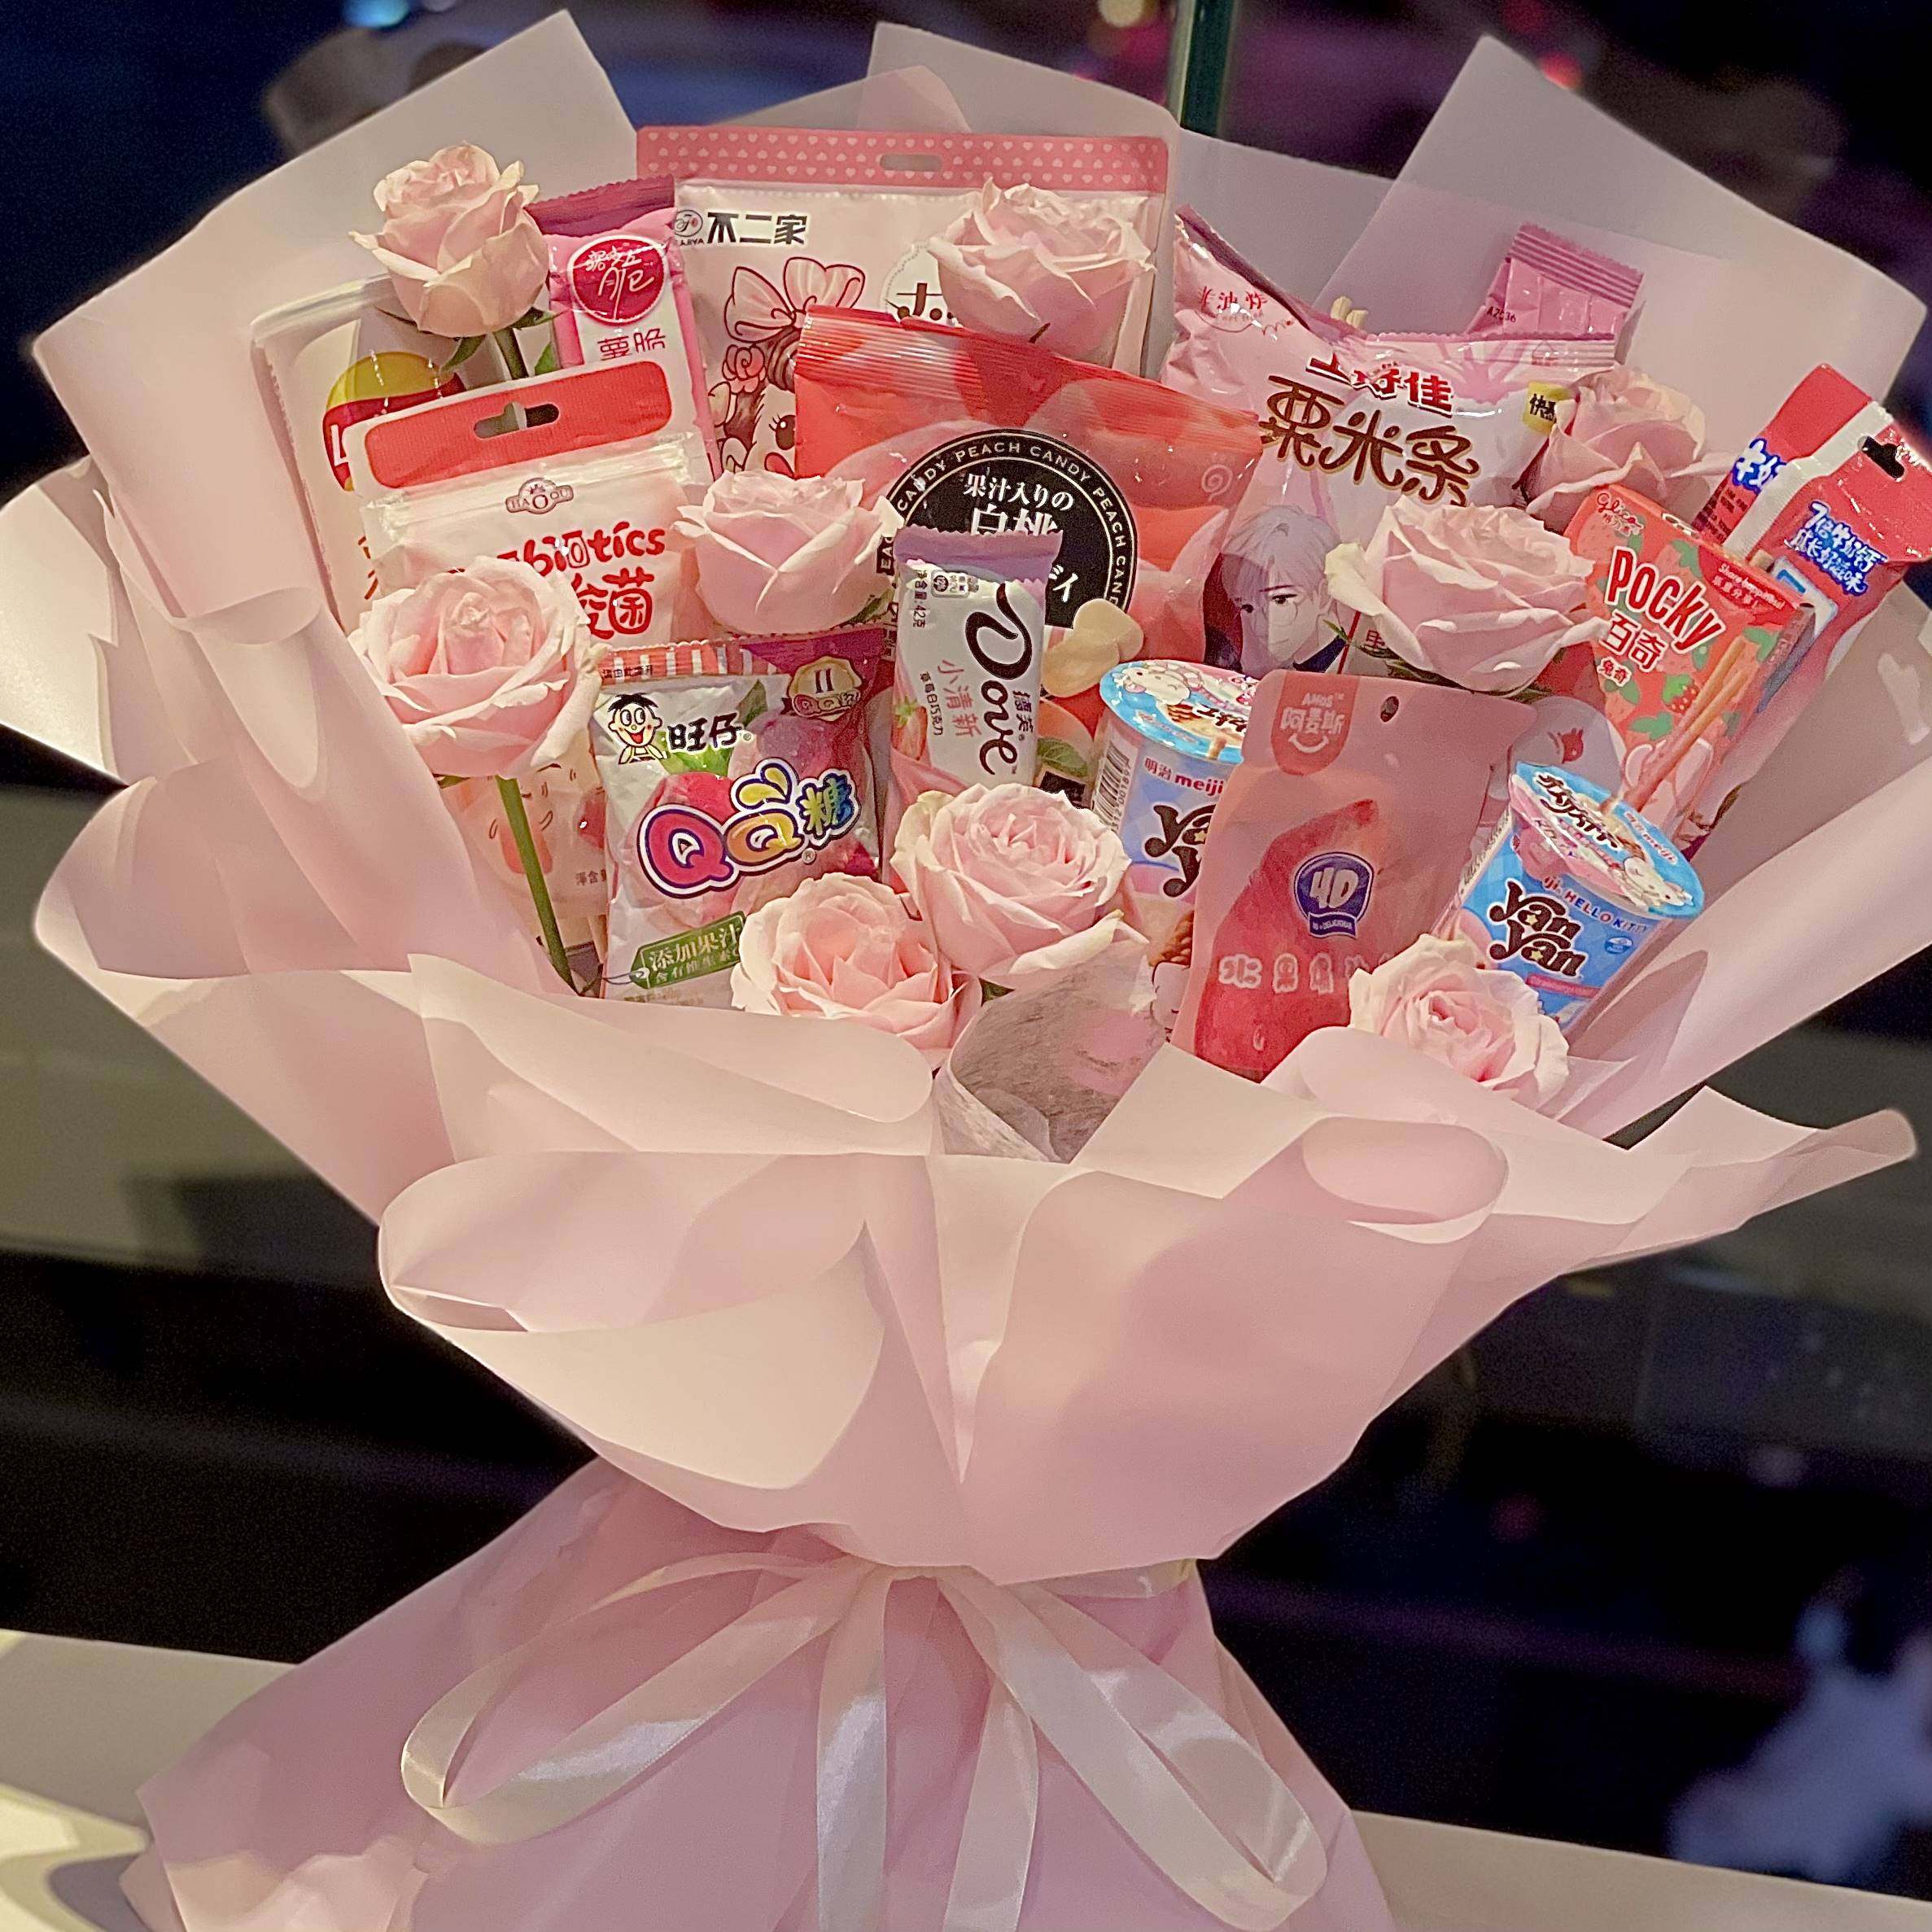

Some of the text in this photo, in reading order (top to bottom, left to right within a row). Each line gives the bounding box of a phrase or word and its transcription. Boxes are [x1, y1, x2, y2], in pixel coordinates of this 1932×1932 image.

[707, 212, 807, 245] 不二家
[597, 328, 667, 361] 薯脆
[1309, 352, 1452, 412] 上好佳
[955, 441, 1021, 463] PEACH
[1029, 446, 1092, 483] CANDY
[1092, 486, 1128, 549] PEACH
[964, 472, 1074, 512] 果汁入りの
[497, 521, 666, 577] biotics
[1599, 611, 1668, 671] 百奇
[937, 659, 983, 738] 小清新
[964, 583, 1033, 776] Dove
[668, 712, 740, 751] 旺仔
[1144, 757, 1172, 781] 明治
[1174, 774, 1224, 797] meiji
[640, 770, 856, 894] QQ糖
[1488, 881, 1581, 940] Yan
[1564, 890, 1612, 923] HELLO
[650, 924, 741, 972] 添加果汁
[1488, 919, 1587, 977] Yan
